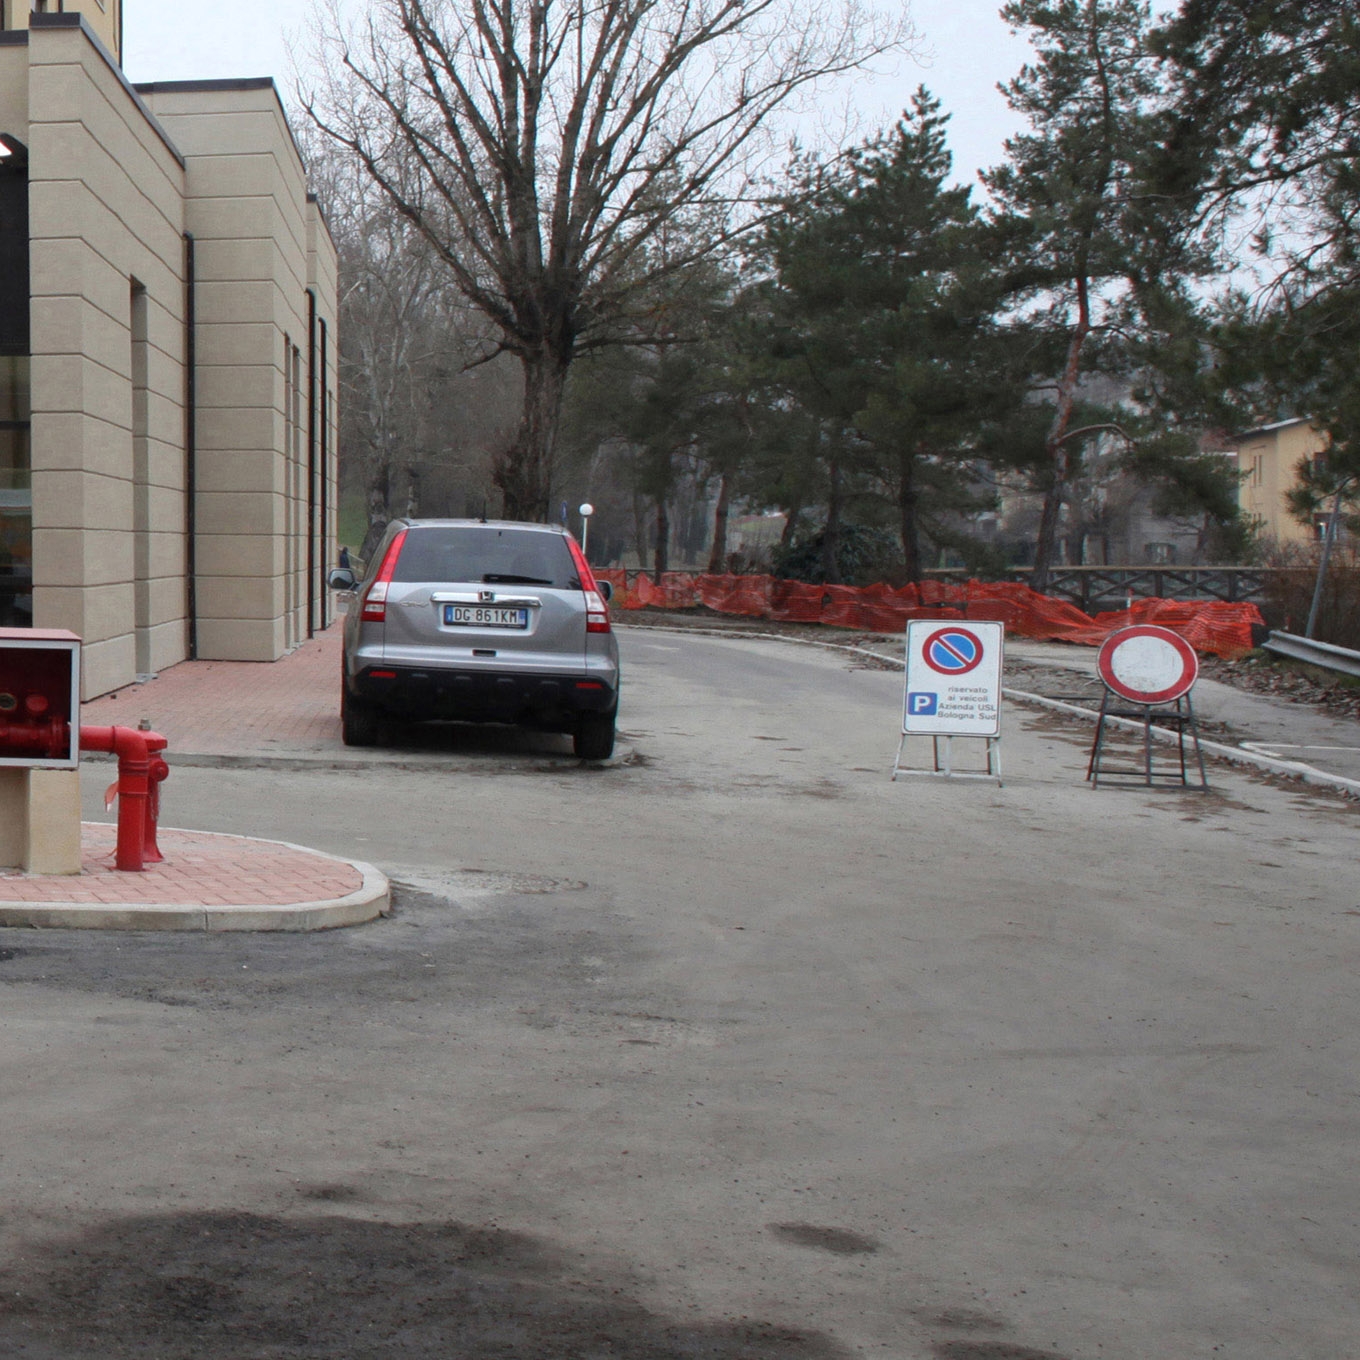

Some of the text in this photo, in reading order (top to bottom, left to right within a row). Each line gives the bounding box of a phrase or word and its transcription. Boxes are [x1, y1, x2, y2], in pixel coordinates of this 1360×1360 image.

[454, 608, 517, 623] DG 861KM
[947, 686, 988, 694] riservato
[914, 696, 931, 712] P
[938, 703, 996, 712] Azienda USL
[938, 711, 997, 721] Bologna Sud
